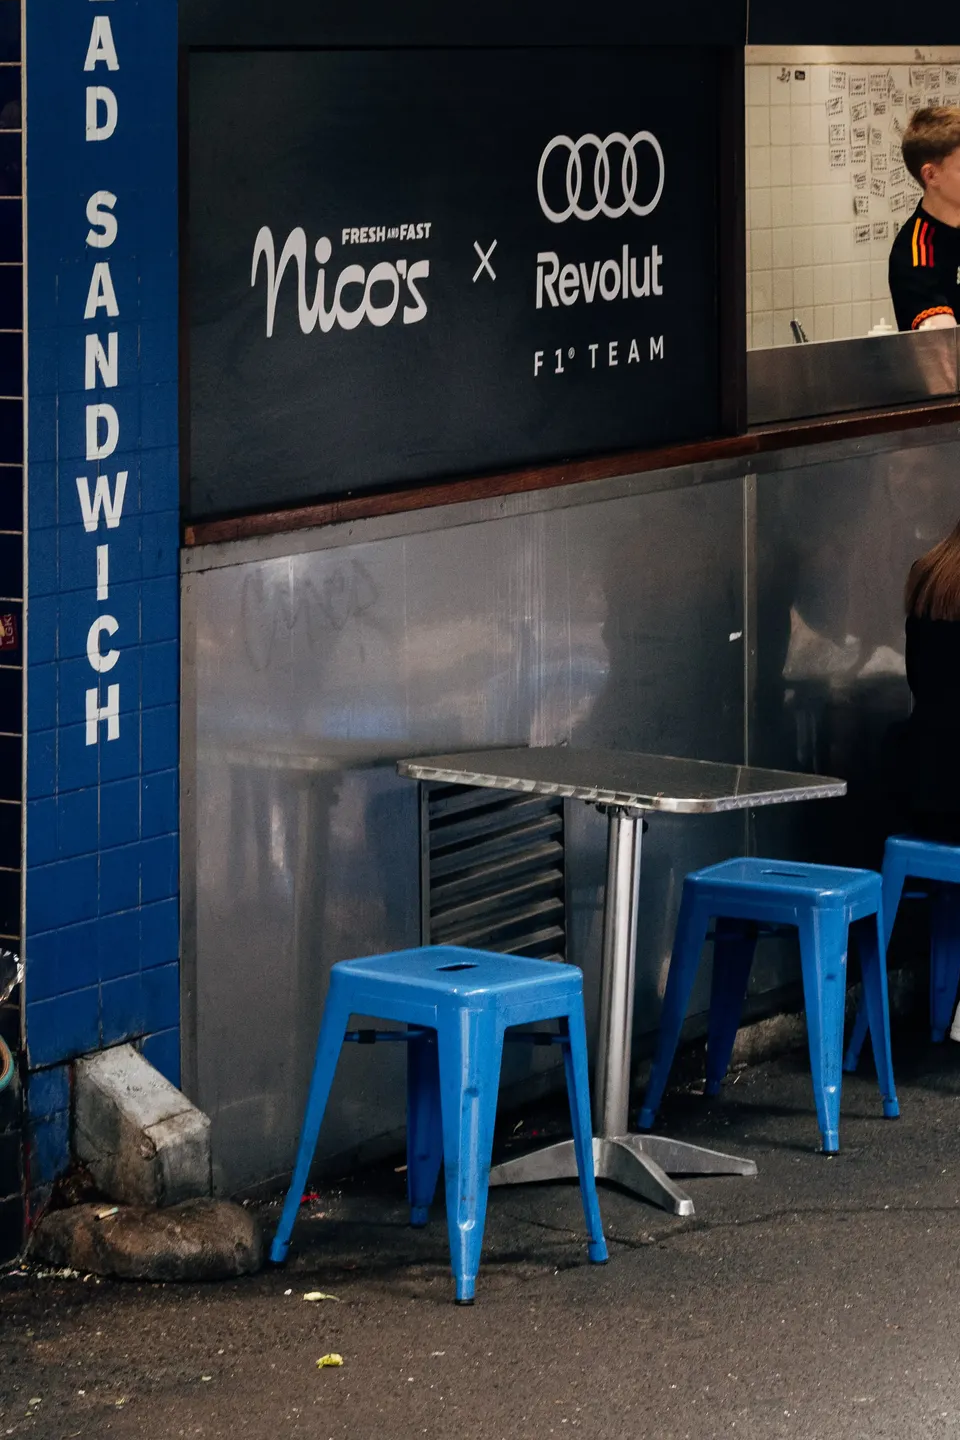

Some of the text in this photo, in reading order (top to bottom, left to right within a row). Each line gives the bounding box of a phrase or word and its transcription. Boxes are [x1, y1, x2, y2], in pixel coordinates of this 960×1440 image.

[342, 222, 432, 245] FRESH AND FAST
[535, 244, 664, 309] Revolut
[589, 335, 664, 370] TEAM
[76, 190, 127, 746] SANDWICH
